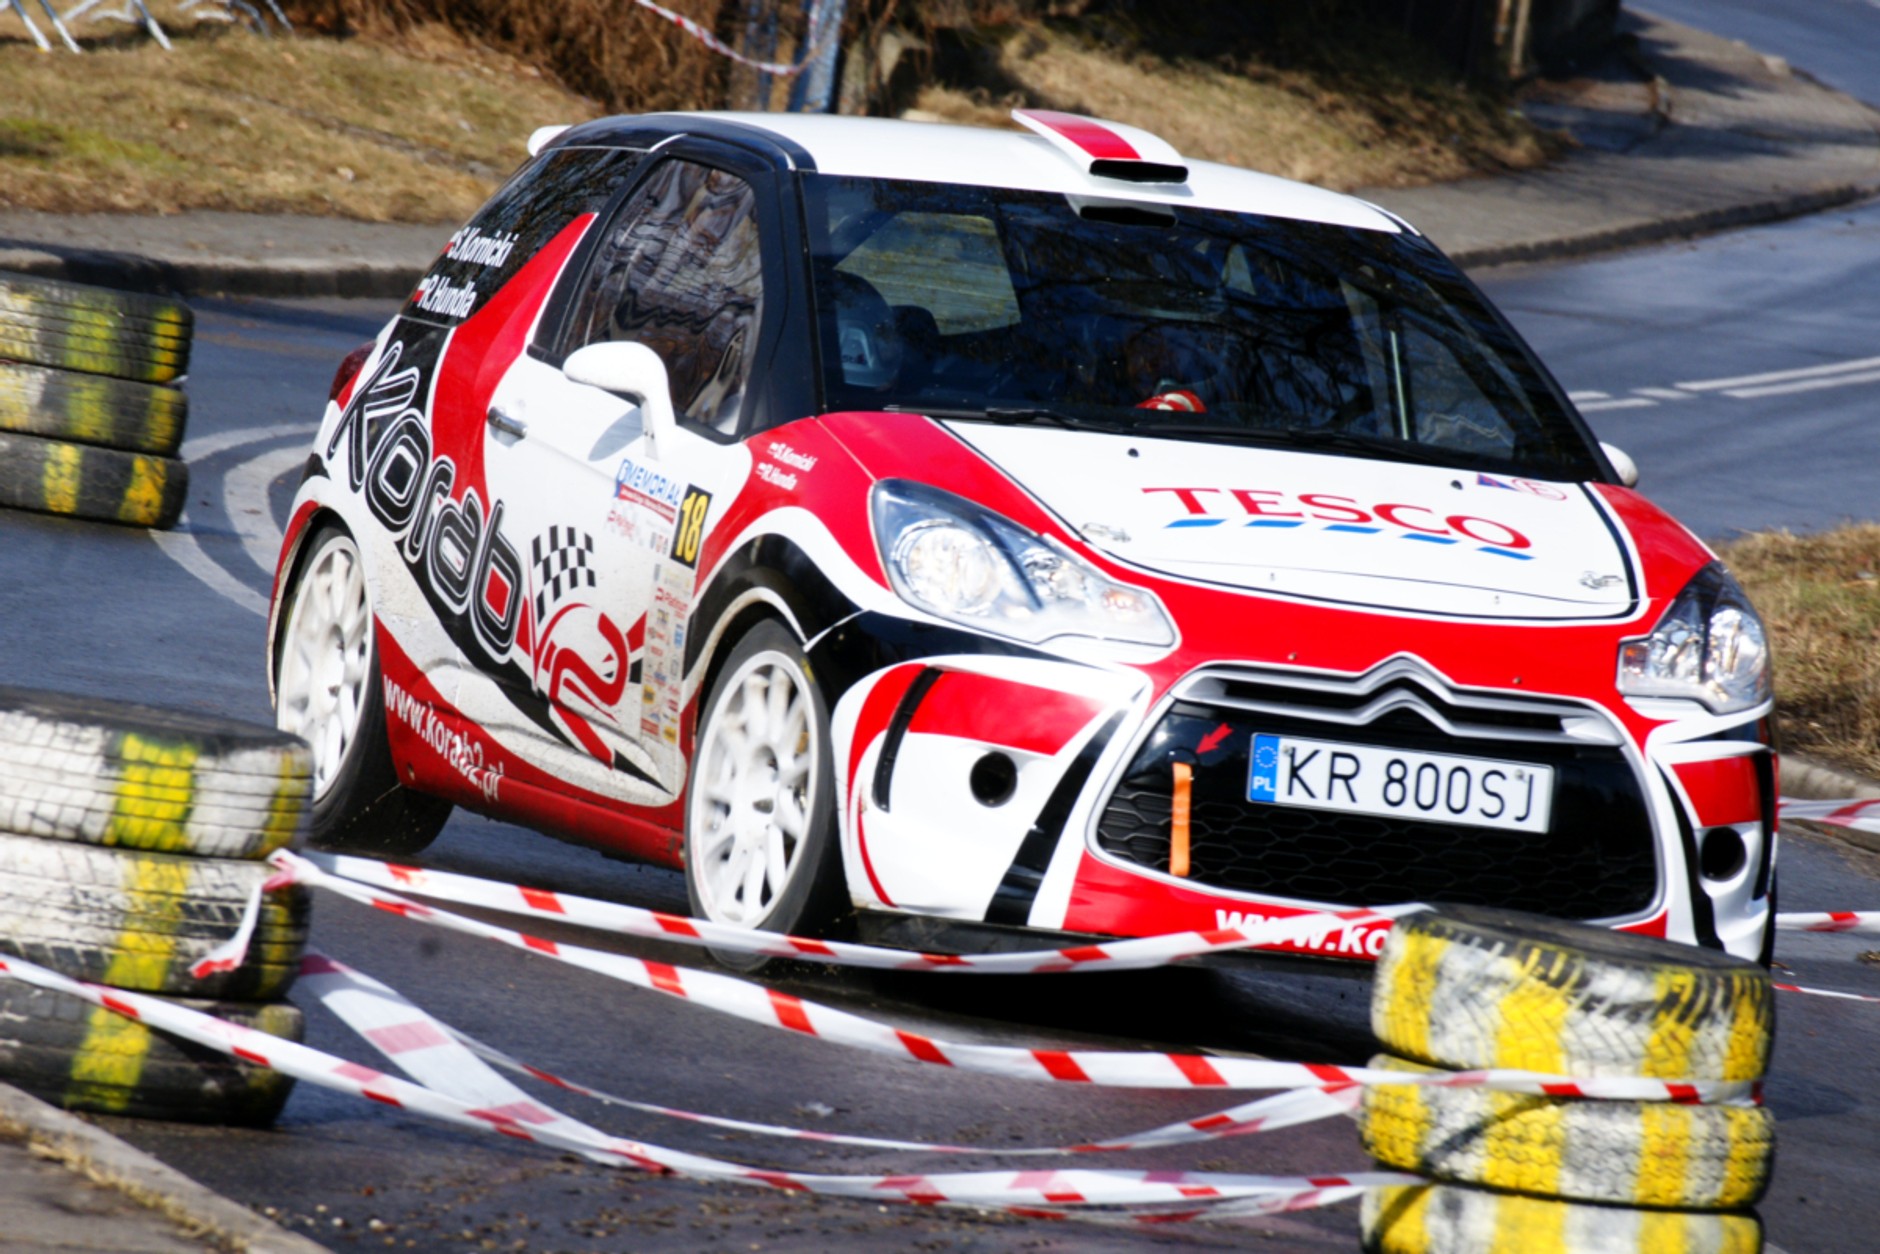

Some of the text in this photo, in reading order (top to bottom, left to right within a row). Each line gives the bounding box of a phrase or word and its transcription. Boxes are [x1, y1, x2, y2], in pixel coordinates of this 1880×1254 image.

[675, 491, 709, 563] 18
[1141, 488, 1532, 549] TESCO
[384, 674, 504, 803] www.korab2.pl
[1252, 775, 1276, 793] PL
[1287, 747, 1534, 823] KR 800SJ
